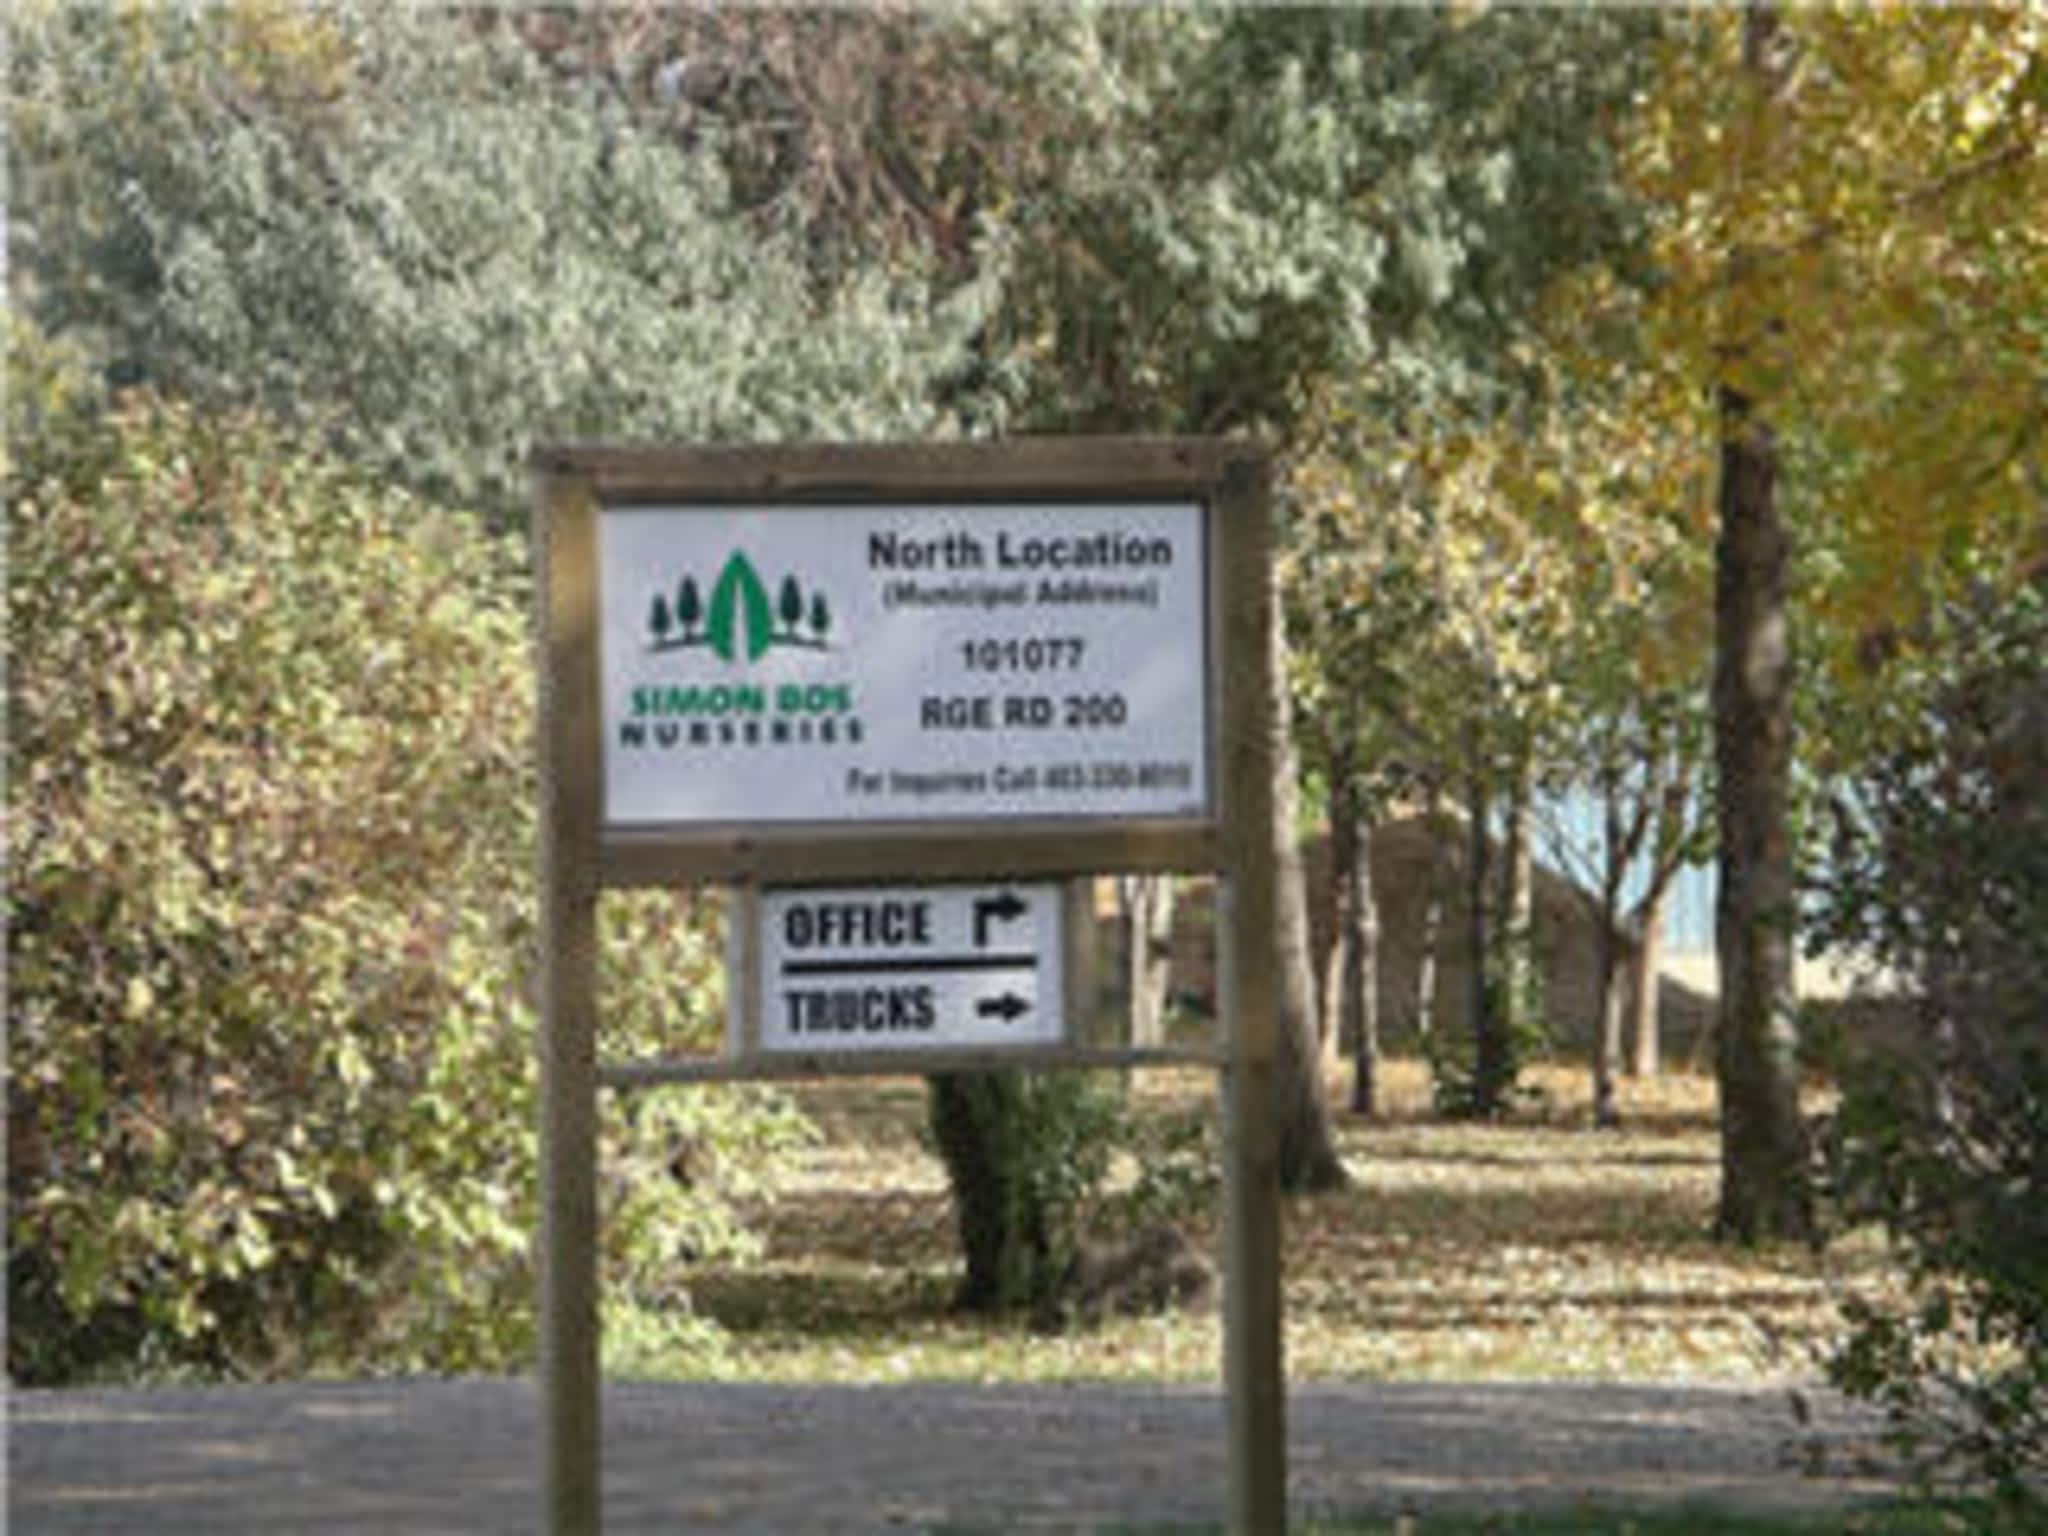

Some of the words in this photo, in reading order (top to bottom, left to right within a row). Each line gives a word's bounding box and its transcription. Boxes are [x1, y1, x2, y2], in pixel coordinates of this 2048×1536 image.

[869, 532, 983, 568] North
[996, 532, 1173, 568] Location
[963, 637, 1084, 671] 101077
[633, 684, 765, 716] SIMON
[921, 697, 992, 730] RGE
[1003, 697, 1055, 728] RD
[1064, 693, 1126, 728] 200
[619, 717, 863, 748] NURSERIES
[785, 902, 931, 948] OFFICE
[785, 987, 936, 1031] TRUCKS
